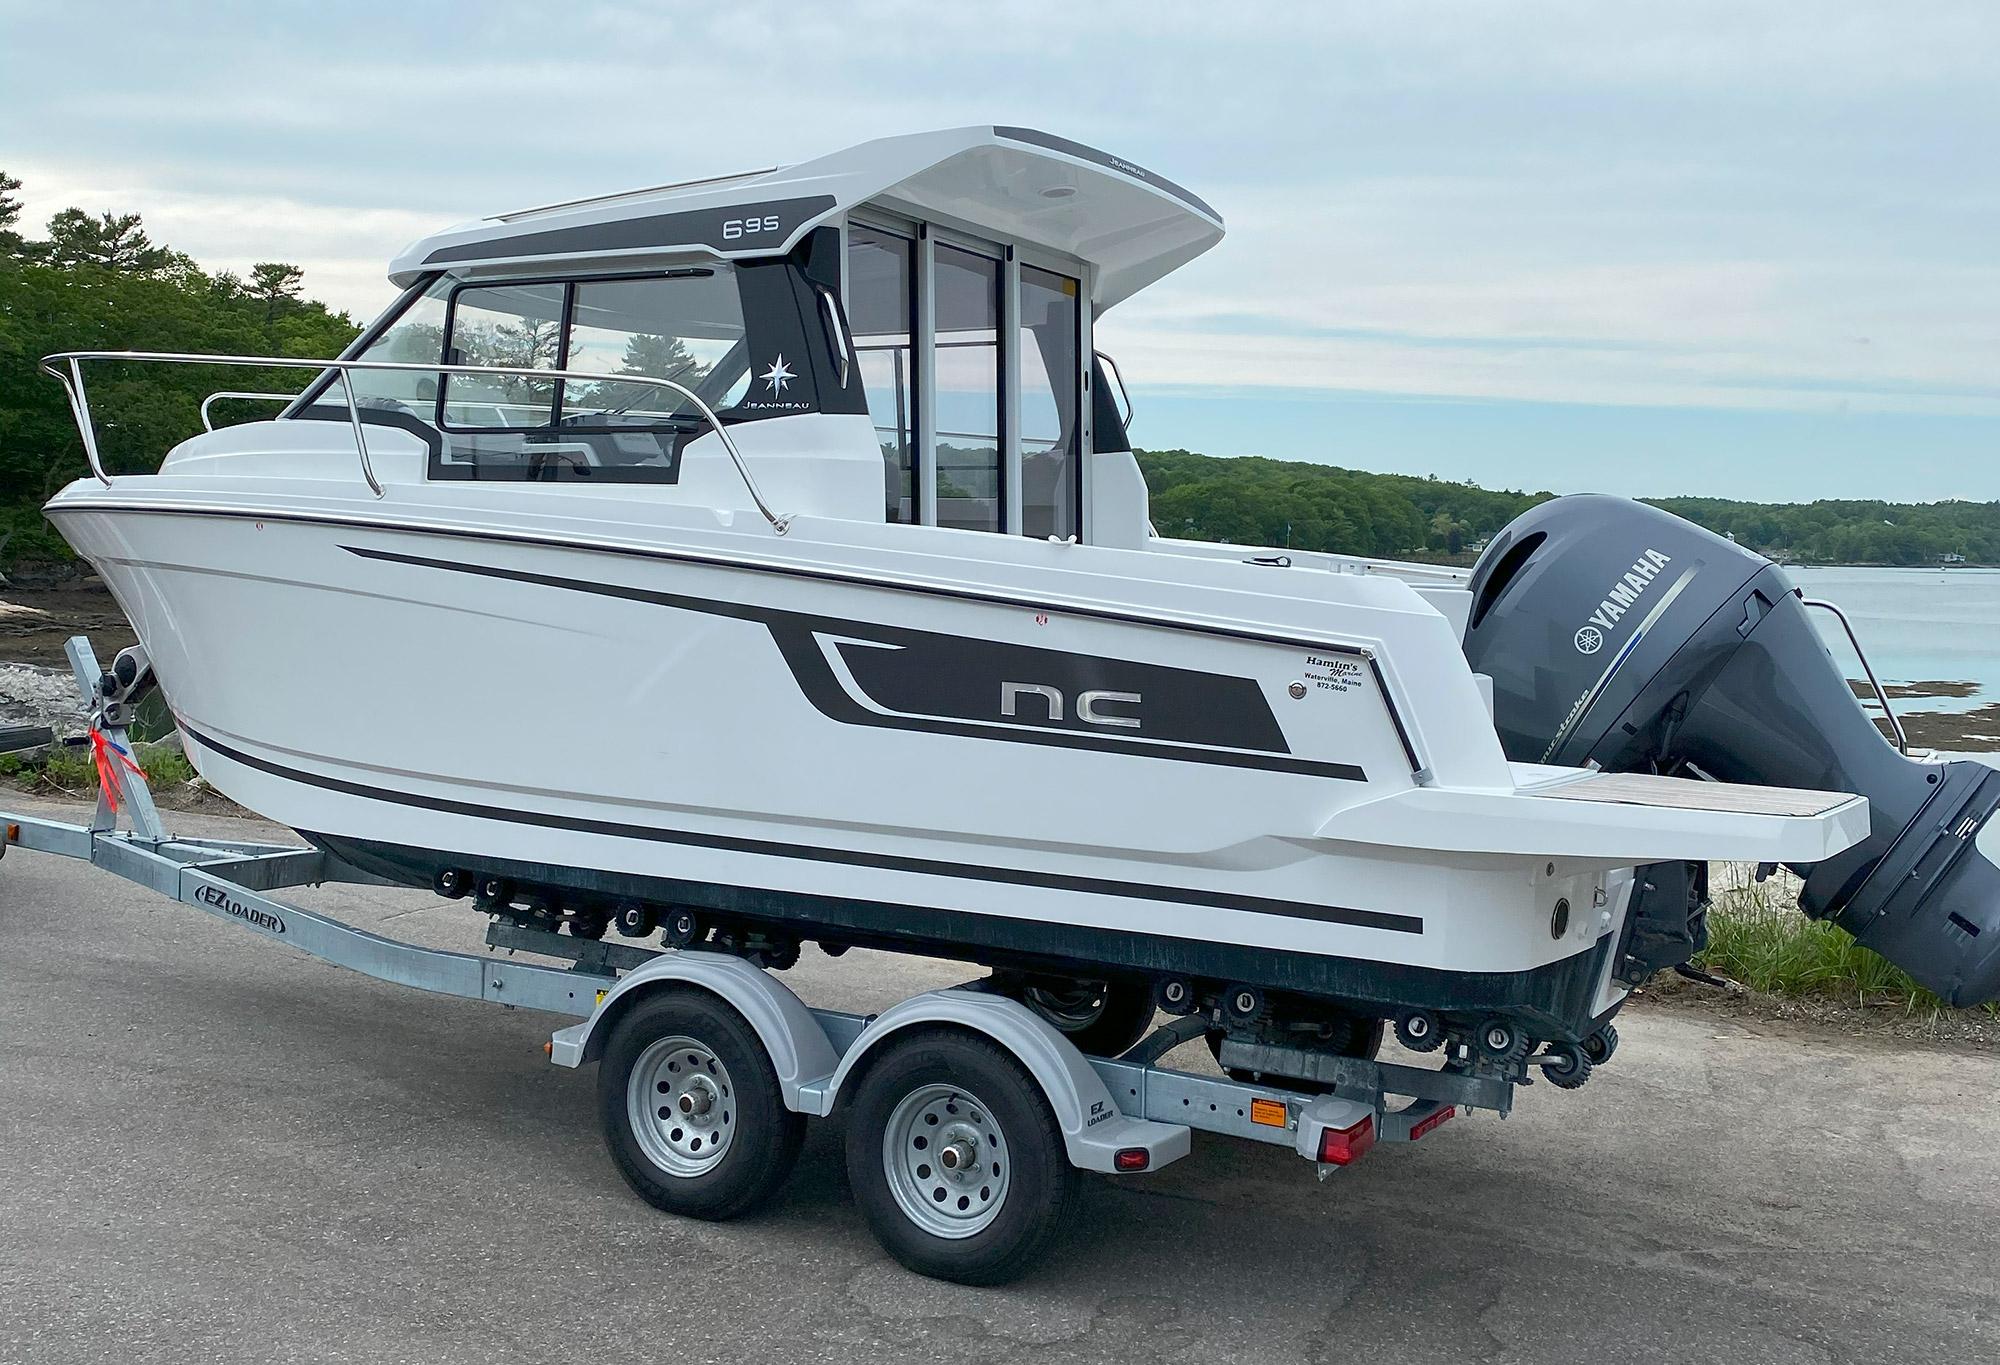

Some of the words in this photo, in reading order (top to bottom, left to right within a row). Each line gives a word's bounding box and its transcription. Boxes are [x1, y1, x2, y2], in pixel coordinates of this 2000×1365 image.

[723, 215, 779, 240] 695
[1588, 548, 1672, 630] YAMAHA
[1306, 656, 1358, 671] Hamlin's
[1304, 672, 1340, 684] Waterville,
[1342, 678, 1362, 687] Maine
[1329, 668, 1363, 677] Marine
[1316, 682, 1348, 692] 872-5660
[203, 886, 227, 910] EZ
[225, 899, 277, 932] LOADER
[1090, 1101, 1104, 1116] EZ
[1087, 1110, 1114, 1127] LOADER
